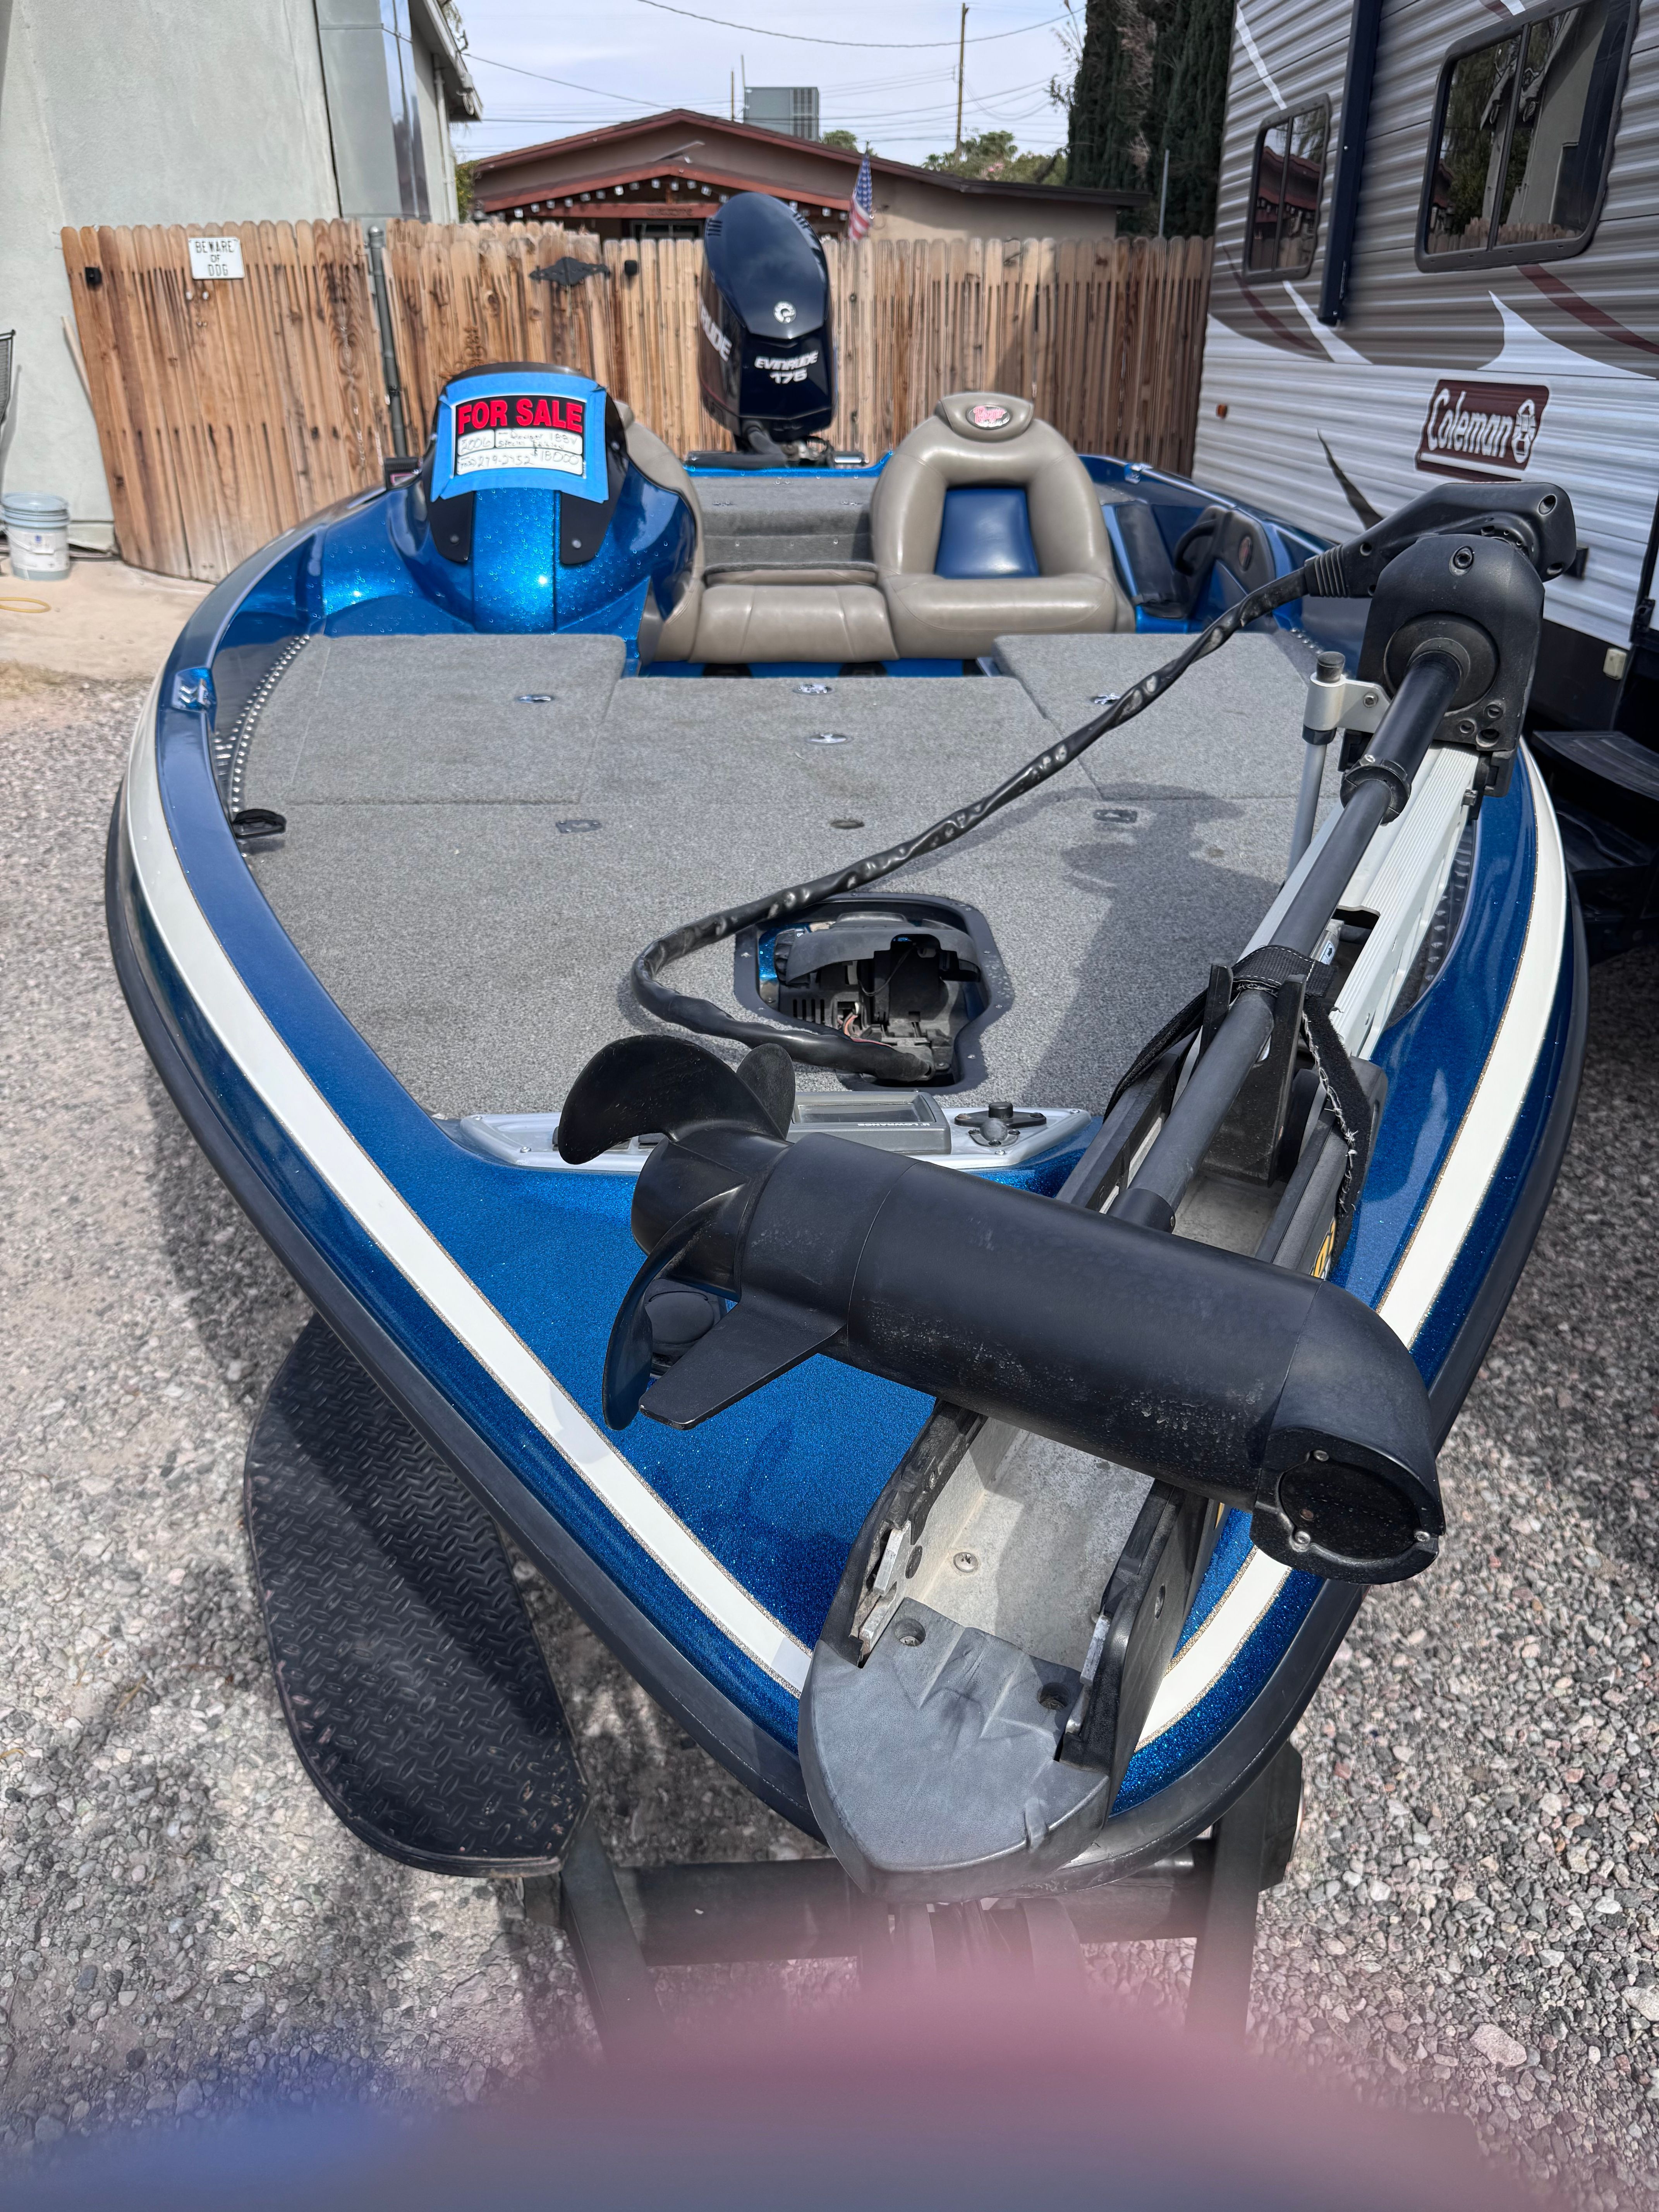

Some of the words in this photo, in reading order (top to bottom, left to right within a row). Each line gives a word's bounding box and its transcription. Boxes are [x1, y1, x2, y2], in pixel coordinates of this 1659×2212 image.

[195, 240, 234, 253] BEWARE
[210, 254, 220, 263] OF
[208, 264, 228, 276] DOG
[754, 350, 819, 371] EVINRUDE
[458, 400, 507, 434] FOR
[516, 399, 582, 433] SALE
[1427, 388, 1514, 458] Coleman
